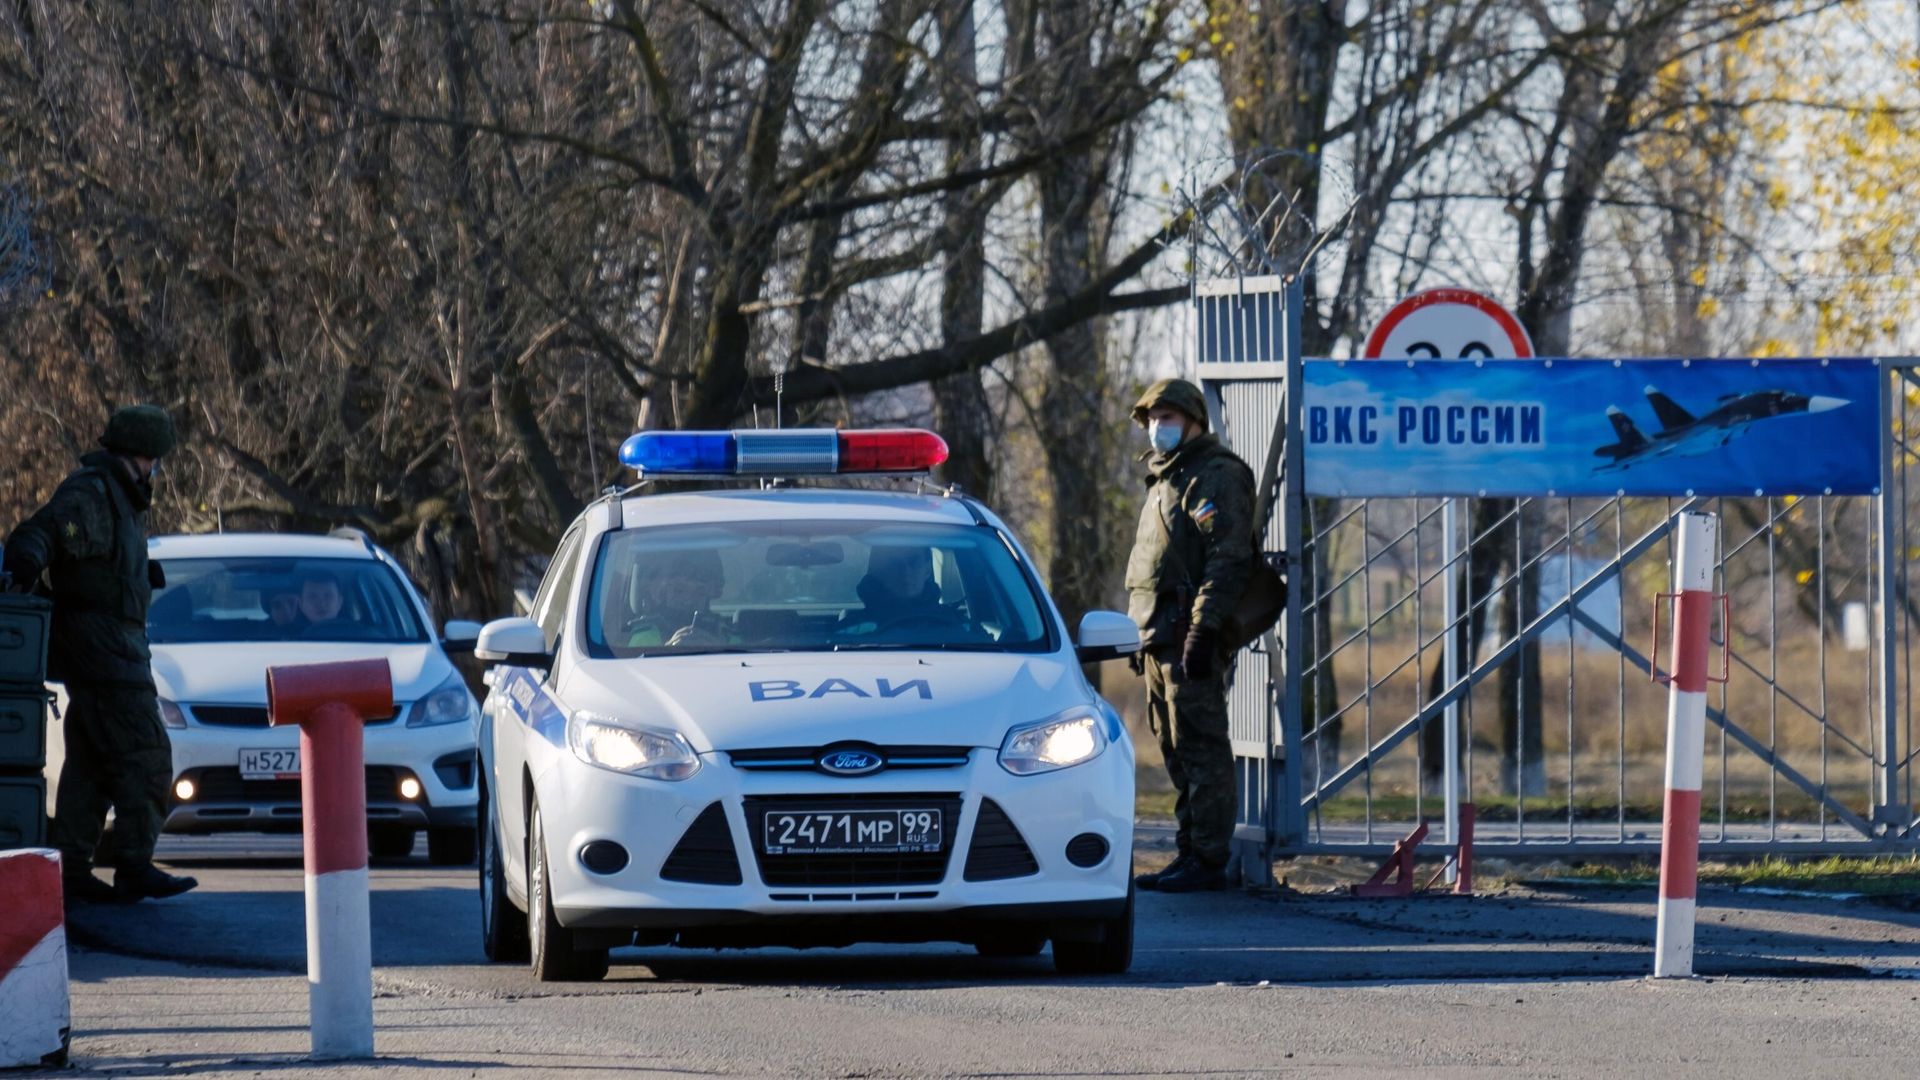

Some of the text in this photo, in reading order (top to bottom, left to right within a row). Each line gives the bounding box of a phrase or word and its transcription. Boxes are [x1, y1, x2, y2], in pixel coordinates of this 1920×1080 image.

[1310, 406, 1540, 444] ВКС РОССИИ
[748, 678, 933, 702] ВАИ
[246, 751, 301, 771] Н527
[834, 751, 868, 768] Ford
[902, 812, 932, 835] 99
[906, 834, 928, 843] RUS
